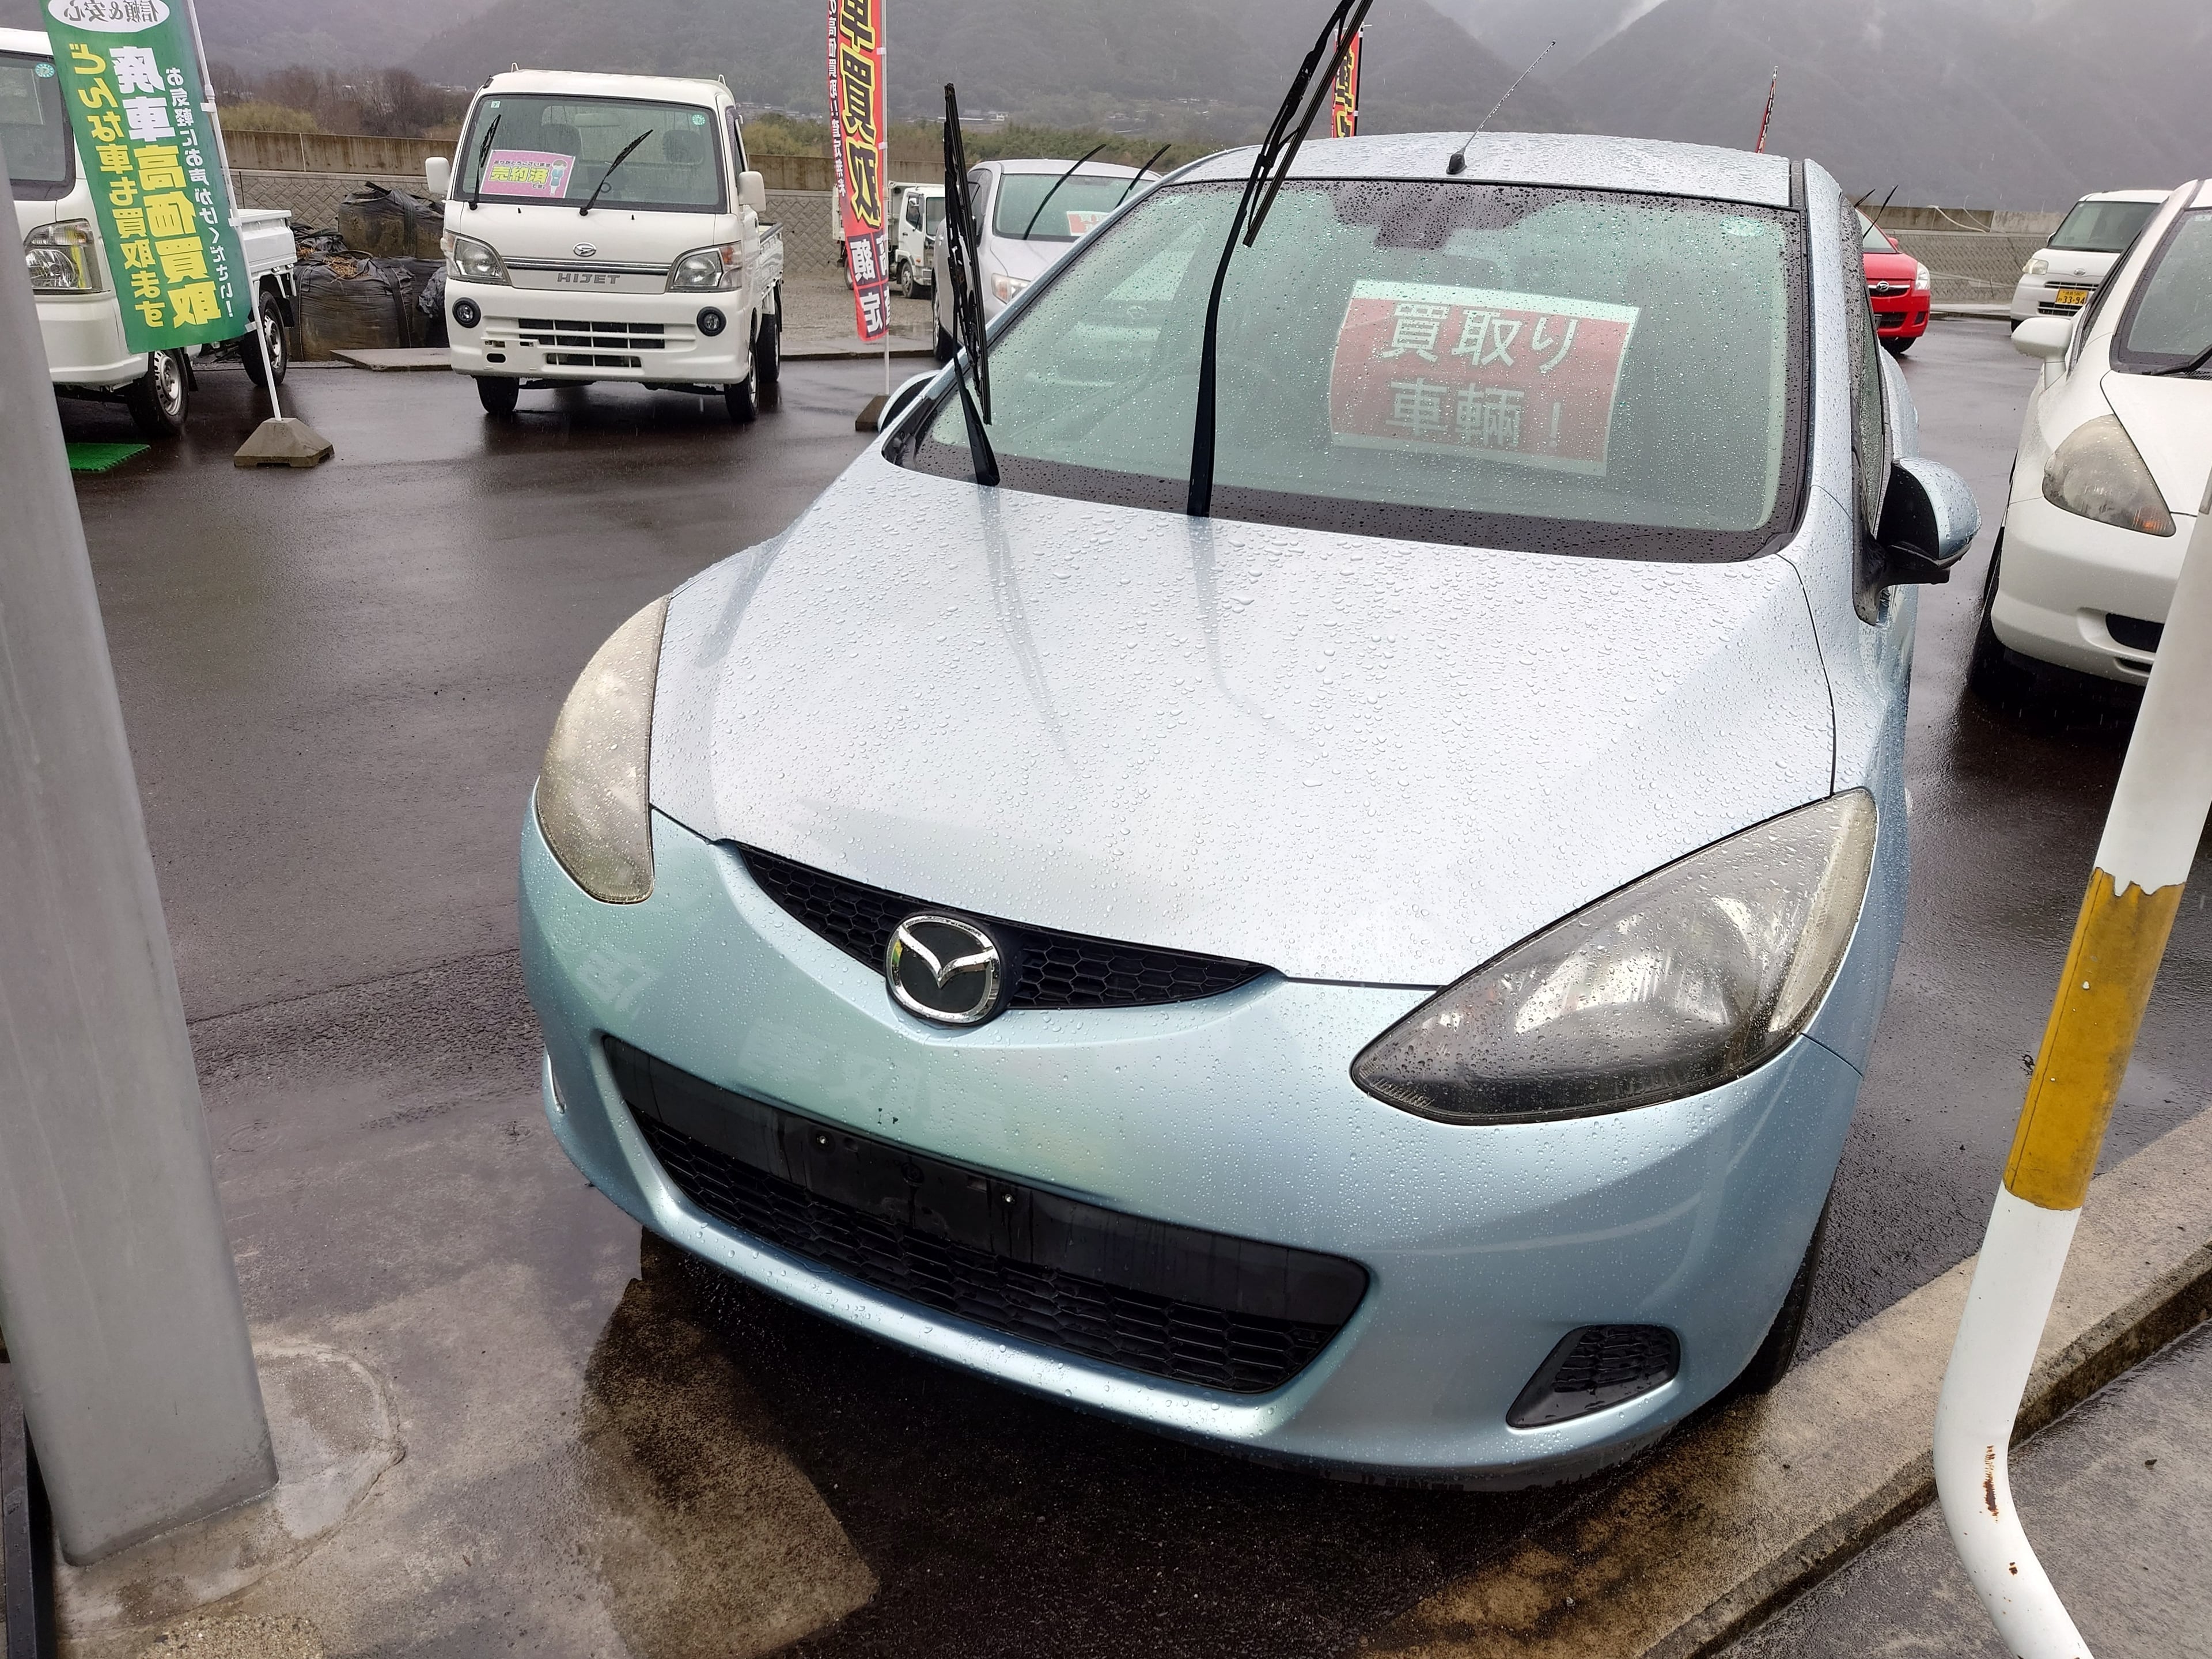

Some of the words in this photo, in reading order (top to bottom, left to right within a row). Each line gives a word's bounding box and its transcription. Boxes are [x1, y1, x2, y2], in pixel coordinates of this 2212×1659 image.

[489, 165, 550, 184] 売約済
[557, 272, 620, 284] HIJET
[1382, 302, 1578, 374] 買取り
